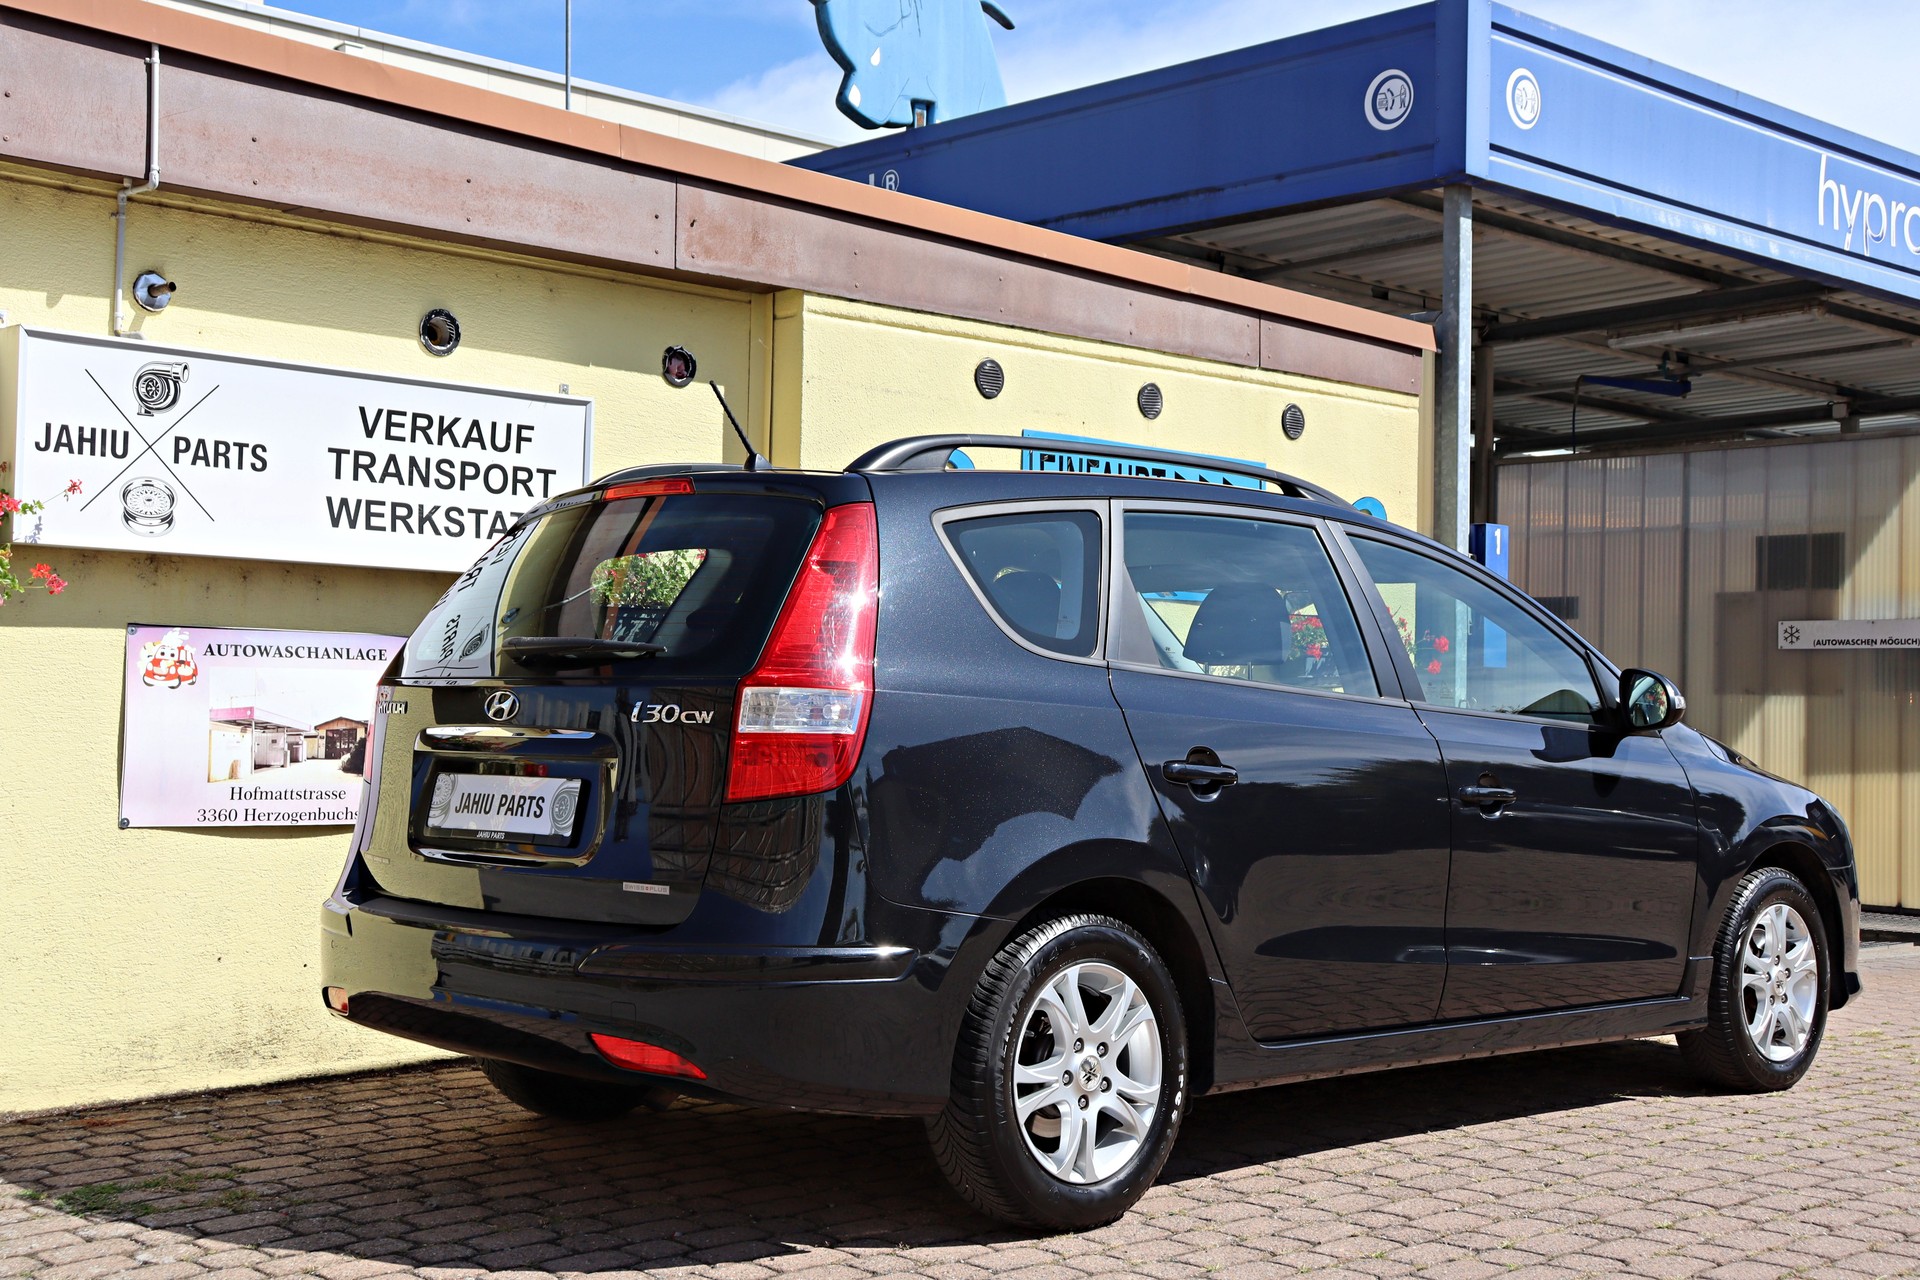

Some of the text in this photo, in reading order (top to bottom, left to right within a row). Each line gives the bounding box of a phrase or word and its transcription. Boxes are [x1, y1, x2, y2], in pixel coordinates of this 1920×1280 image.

[358, 405, 535, 455] VERKAUF
[34, 422, 269, 473] JAHIU PARTS
[327, 447, 557, 499] TRANSPORT
[326, 496, 525, 541] WERKSTA
[1494, 528, 1502, 555] 1
[203, 643, 388, 661] AUTOWASCHANLAGE
[229, 786, 347, 801] Hofmattstrasse
[454, 792, 545, 819] JAHIU PARTS
[197, 808, 238, 822] 3360
[476, 830, 505, 840] JAHIU PARTS
